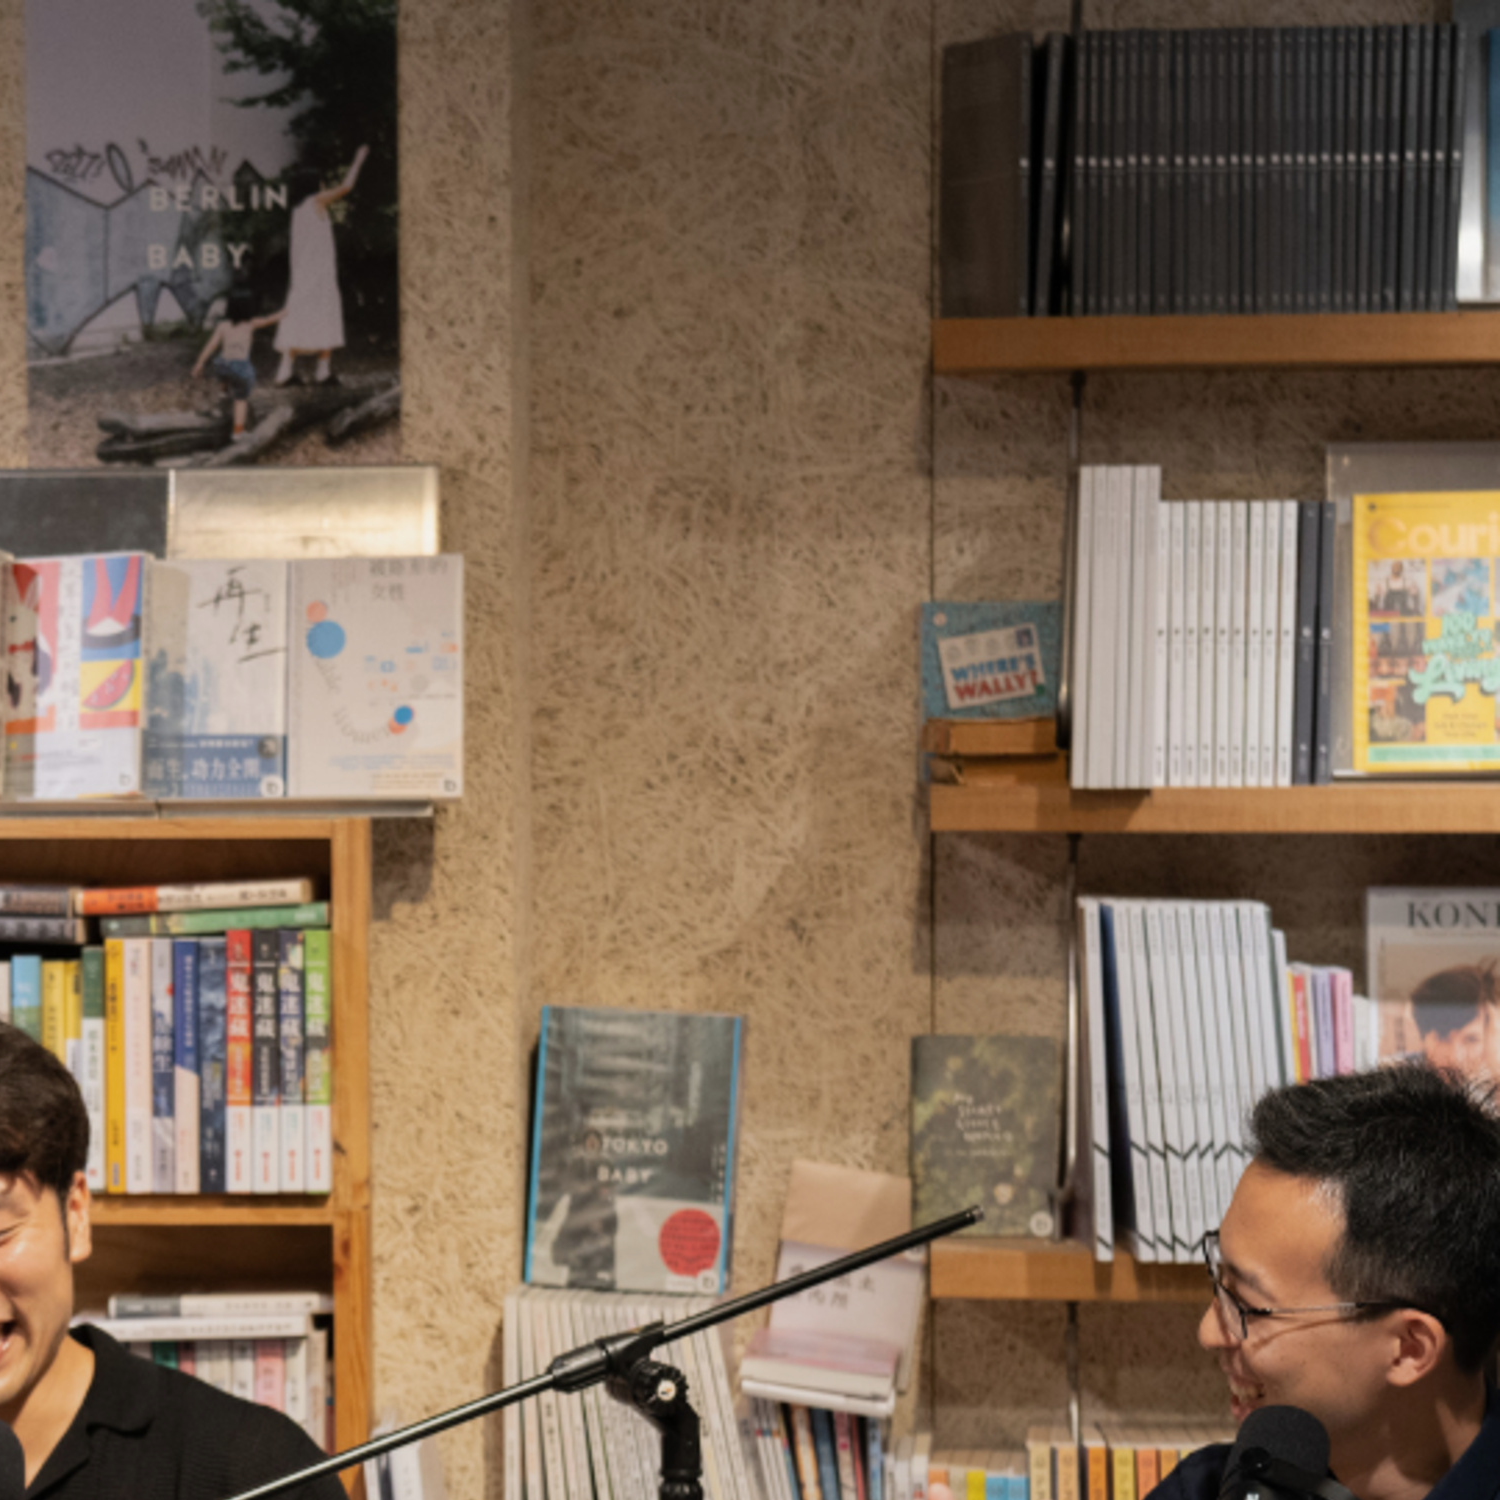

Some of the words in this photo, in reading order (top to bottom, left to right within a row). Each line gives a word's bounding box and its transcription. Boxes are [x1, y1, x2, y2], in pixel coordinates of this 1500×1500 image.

[150, 184, 288, 212] BERLIN
[148, 243, 248, 271] BABY
[1407, 901, 1500, 929] KON
[601, 1136, 668, 1156] TOKYO
[597, 1165, 654, 1184] BABY
